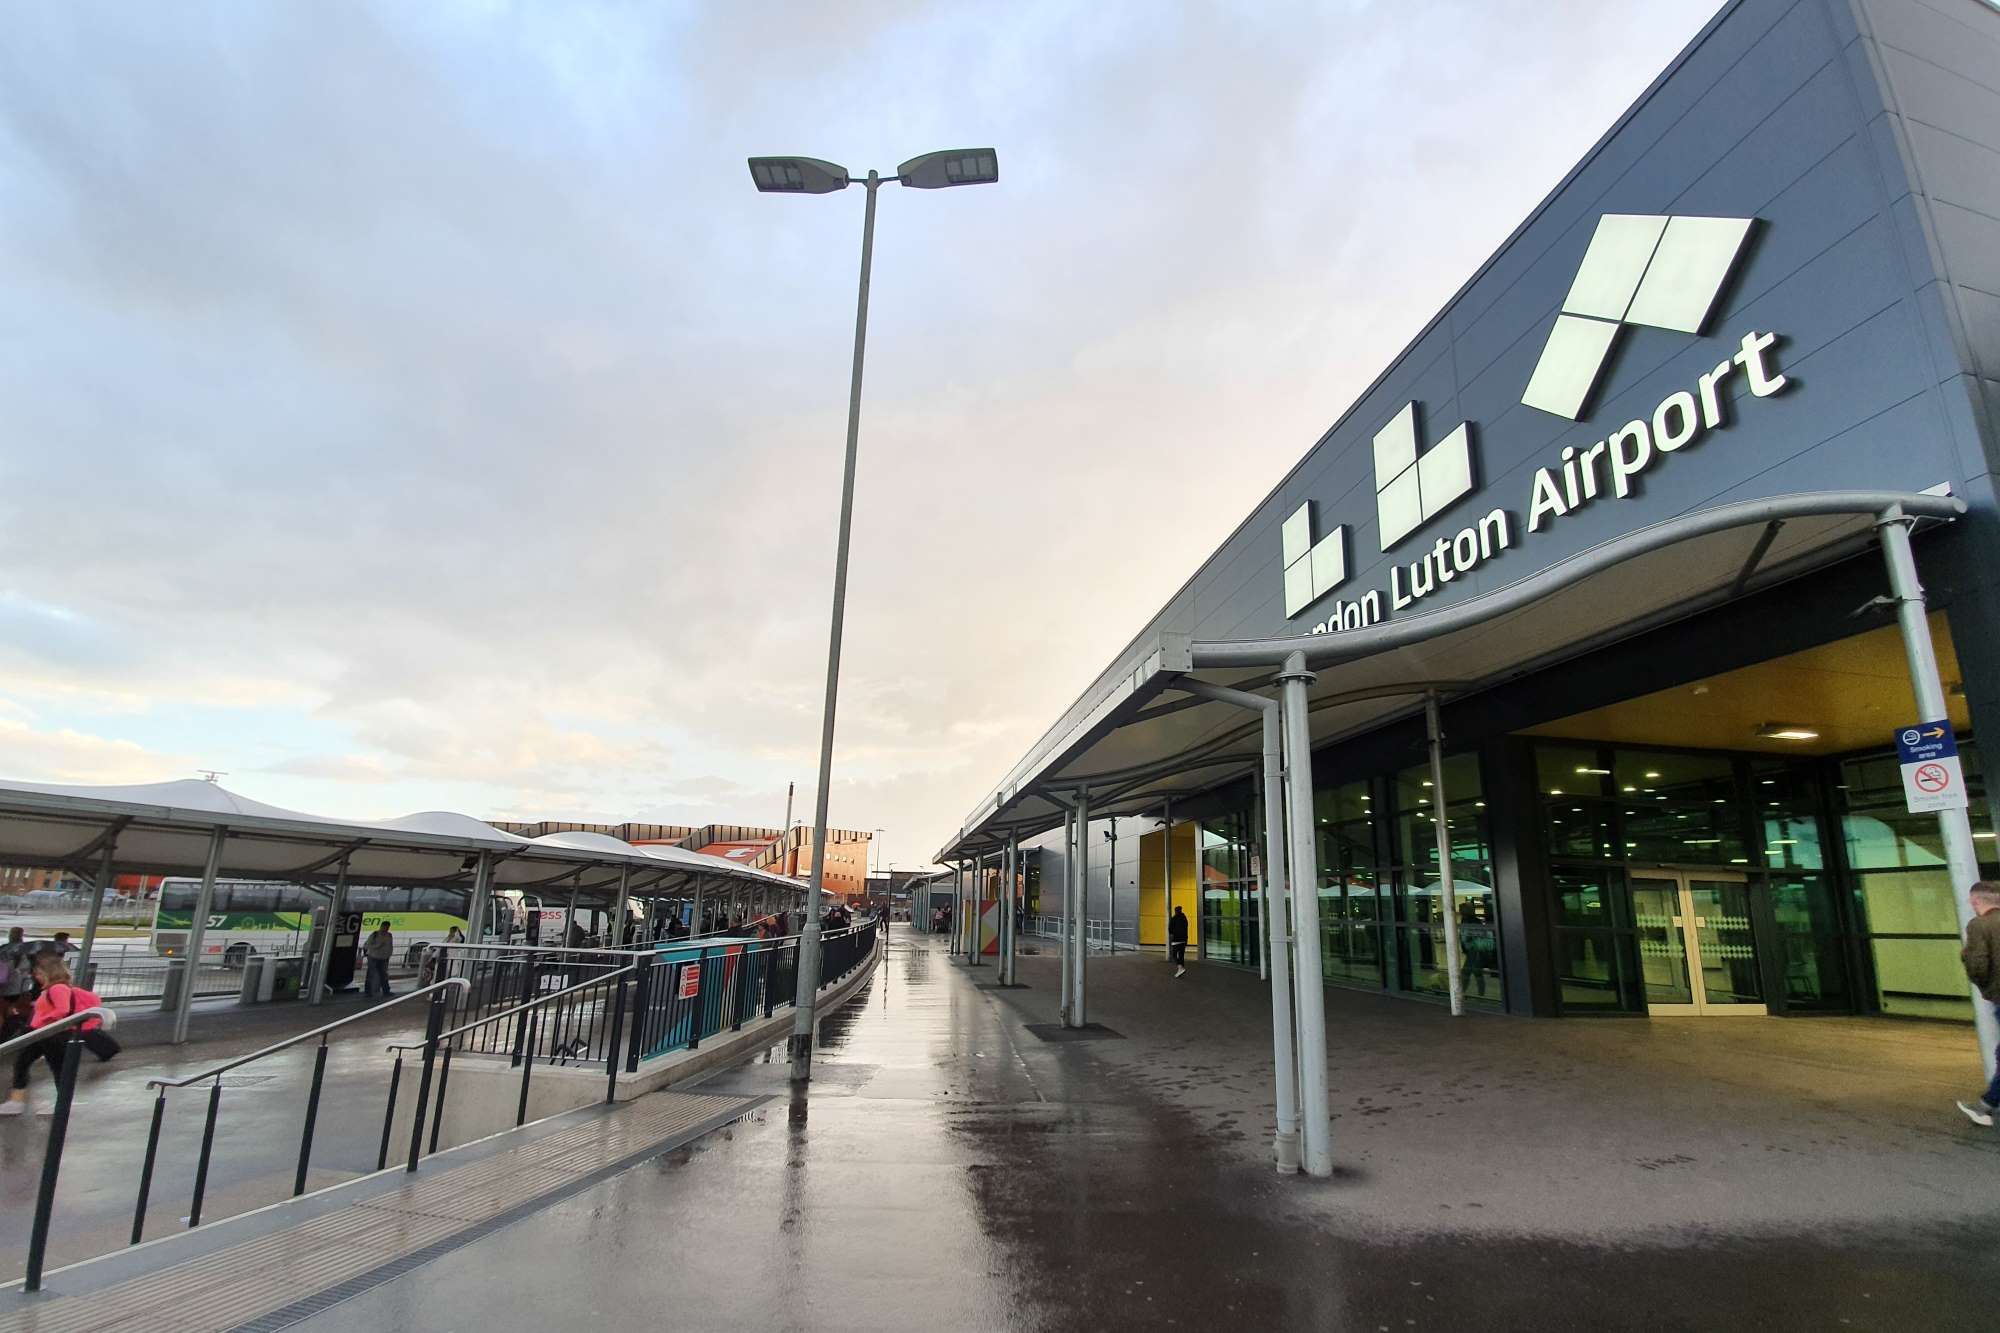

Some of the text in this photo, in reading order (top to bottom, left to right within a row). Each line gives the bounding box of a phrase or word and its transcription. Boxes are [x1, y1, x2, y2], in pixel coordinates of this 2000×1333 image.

[1390, 508, 1510, 612] Luton
[1527, 330, 1787, 534] Airport
[1909, 743, 1943, 753] Smoking
